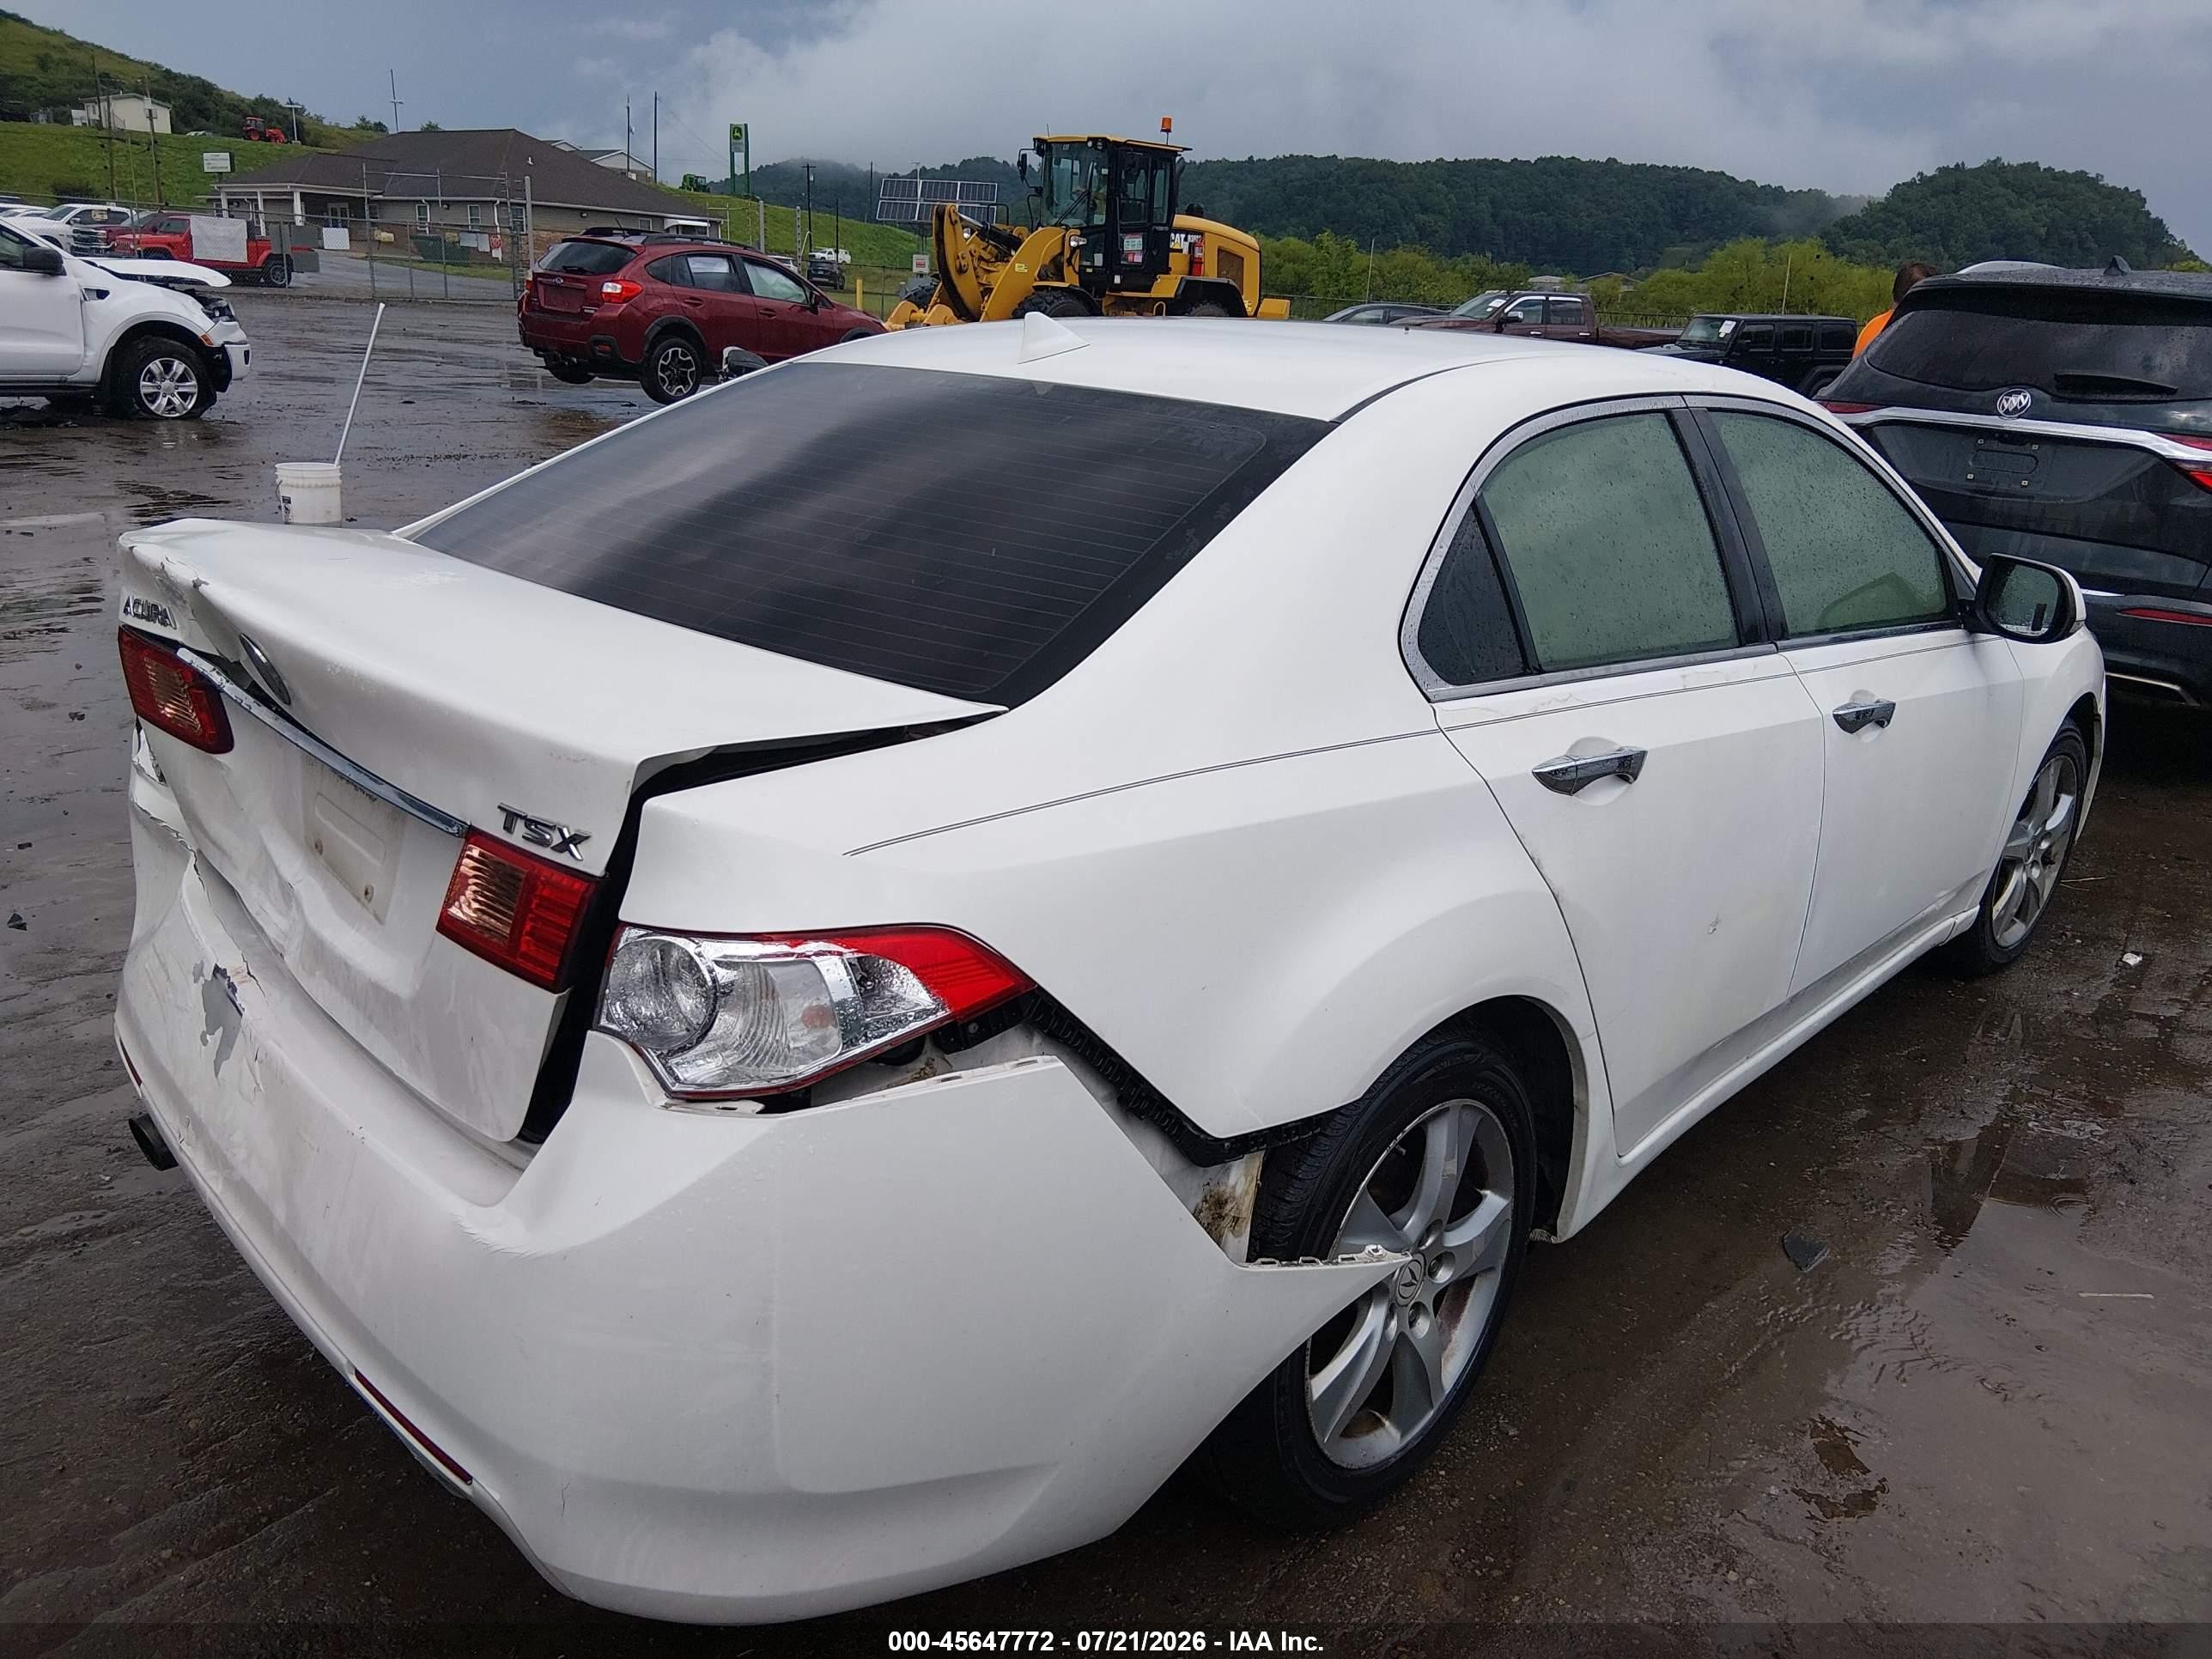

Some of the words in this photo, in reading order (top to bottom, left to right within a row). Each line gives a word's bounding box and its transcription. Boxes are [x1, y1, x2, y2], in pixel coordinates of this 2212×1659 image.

[1170, 232, 1186, 249] CAT
[123, 595, 178, 630] ACURA
[496, 802, 592, 861] TSX
